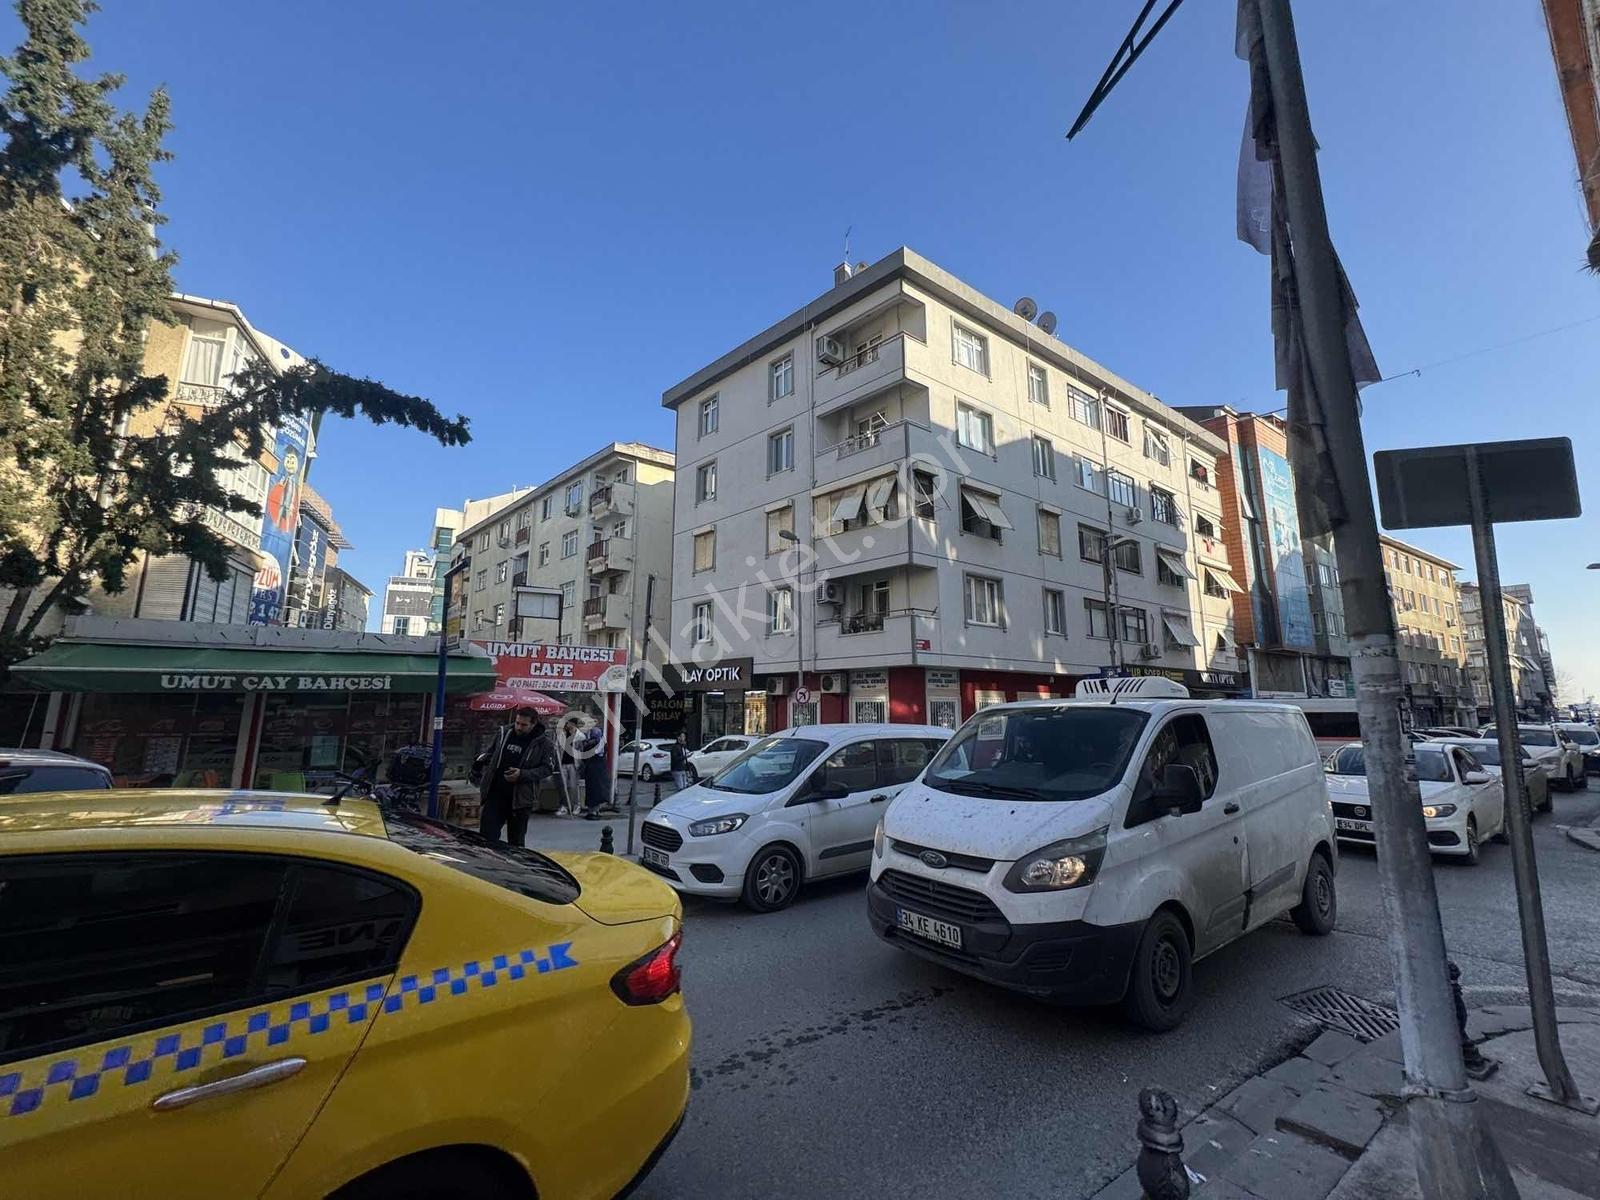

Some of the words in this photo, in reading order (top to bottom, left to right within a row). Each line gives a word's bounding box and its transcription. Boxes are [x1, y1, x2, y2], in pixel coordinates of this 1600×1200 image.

[323, 588, 338, 630] Dünyagöz
[486, 642, 541, 658] UMUT
[530, 662, 574, 677] CAFE
[706, 666, 740, 682] OPTİK
[161, 674, 236, 690] UMUT
[243, 675, 292, 691] ÇAY
[298, 674, 391, 691] BAHÇESİ
[480, 702, 507, 710] ALGIDA
[650, 699, 684, 709] SALON
[902, 911, 913, 927] 34
[917, 916, 929, 933] KE
[934, 921, 959, 943] 4610
